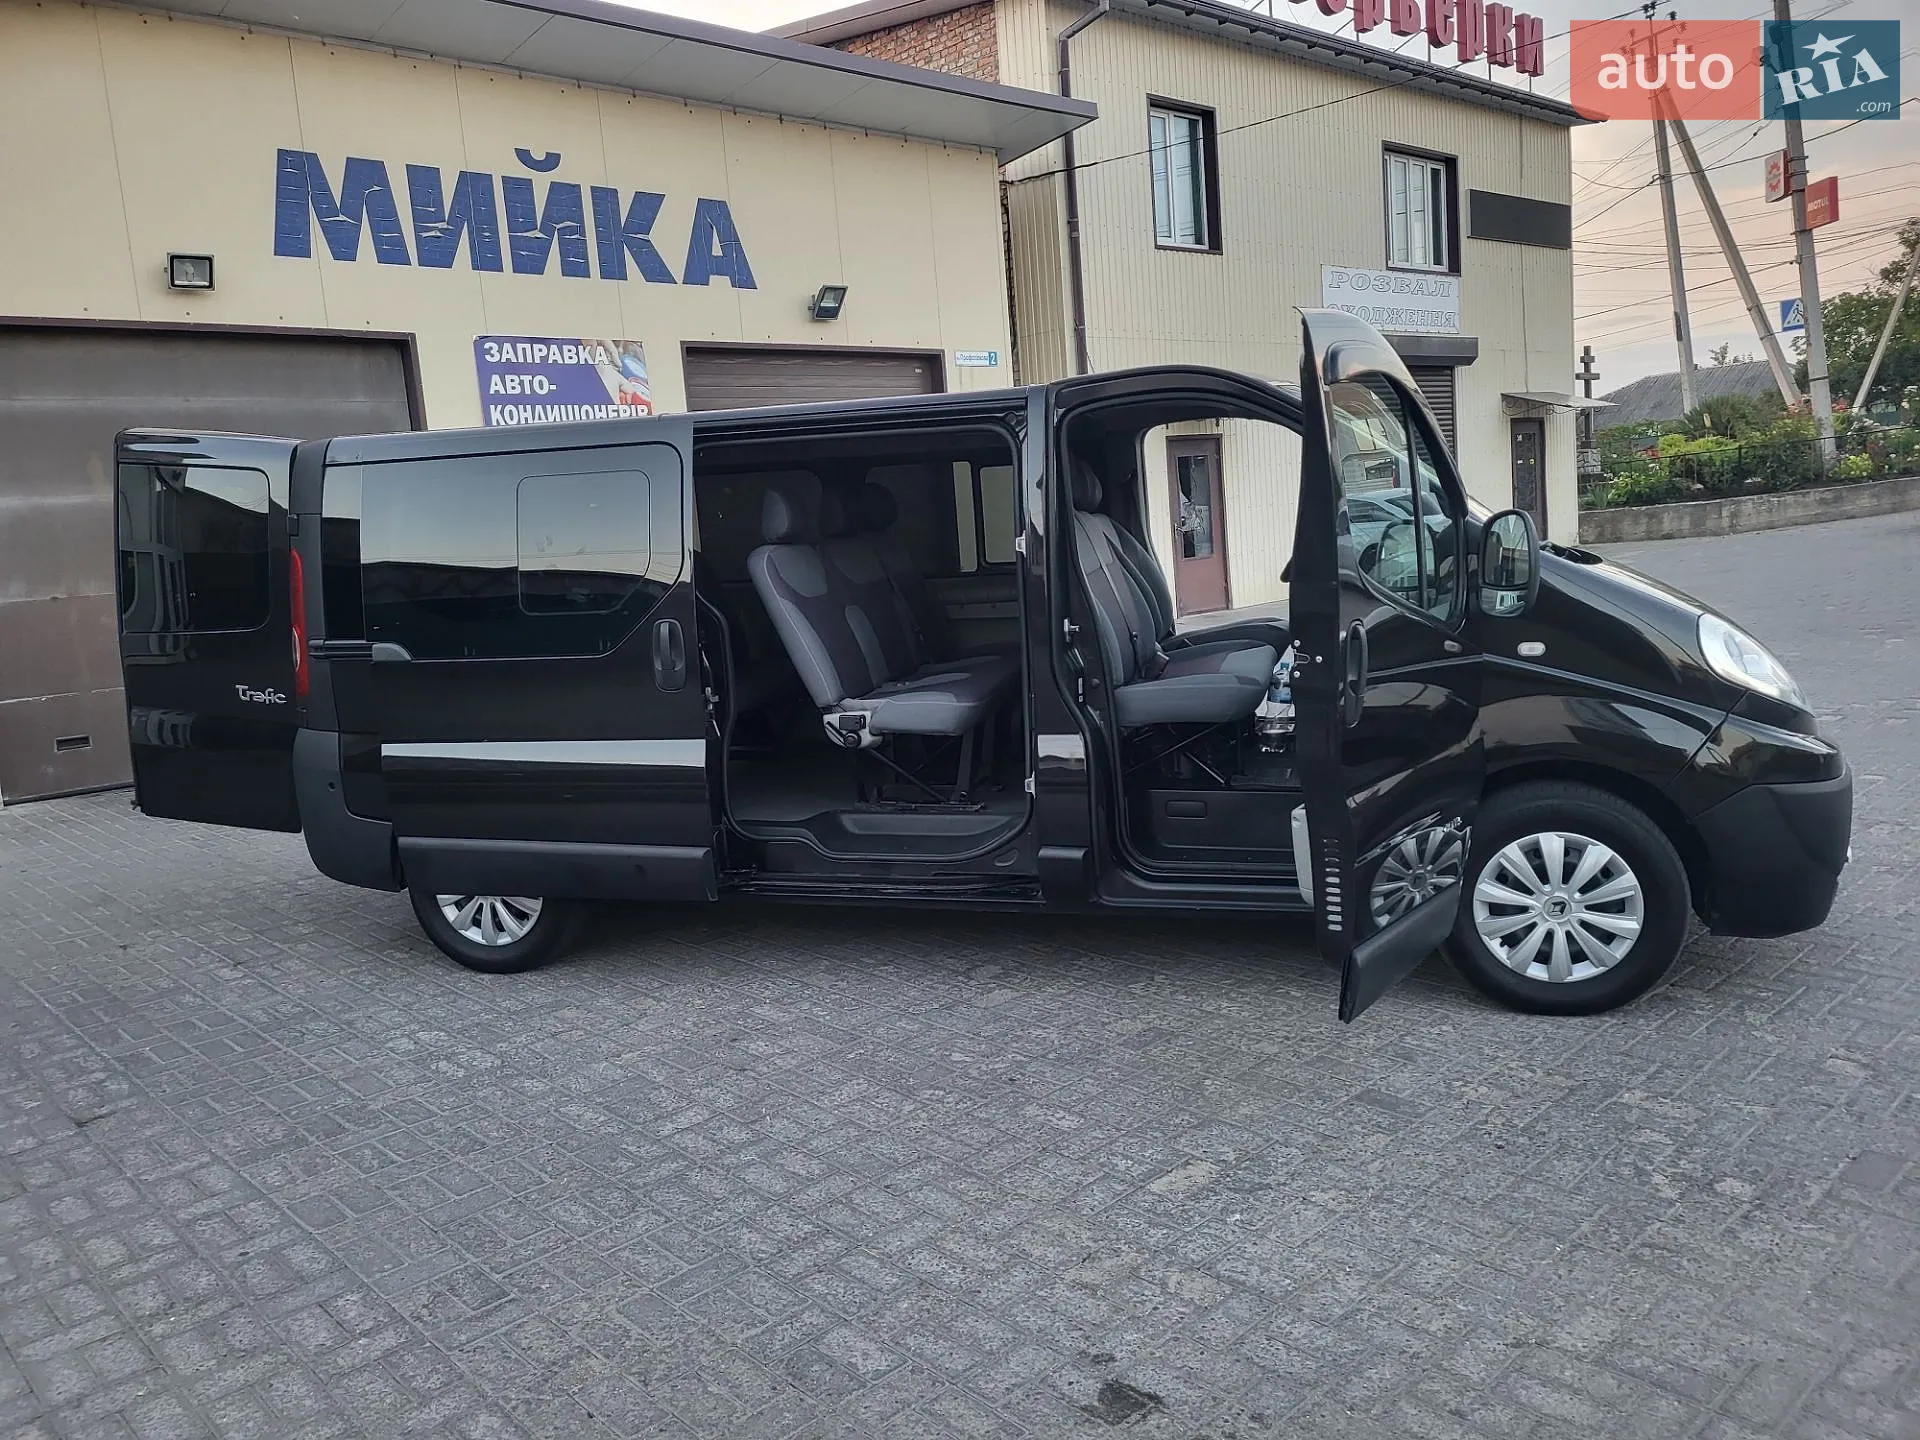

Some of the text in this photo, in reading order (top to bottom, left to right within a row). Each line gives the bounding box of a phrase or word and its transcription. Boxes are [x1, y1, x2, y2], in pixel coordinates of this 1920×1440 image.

[1807, 196, 1829, 212] MOTUL
[273, 147, 758, 290] МИЙКА
[1328, 271, 1452, 298] РОЗВАЛ
[1326, 303, 1456, 328] ОДЖЕННЯ
[483, 342, 610, 365] ЗАПРАВКА
[990, 352, 996, 365] 2
[489, 374, 557, 395] АВТО-
[235, 684, 287, 705] Trafic
